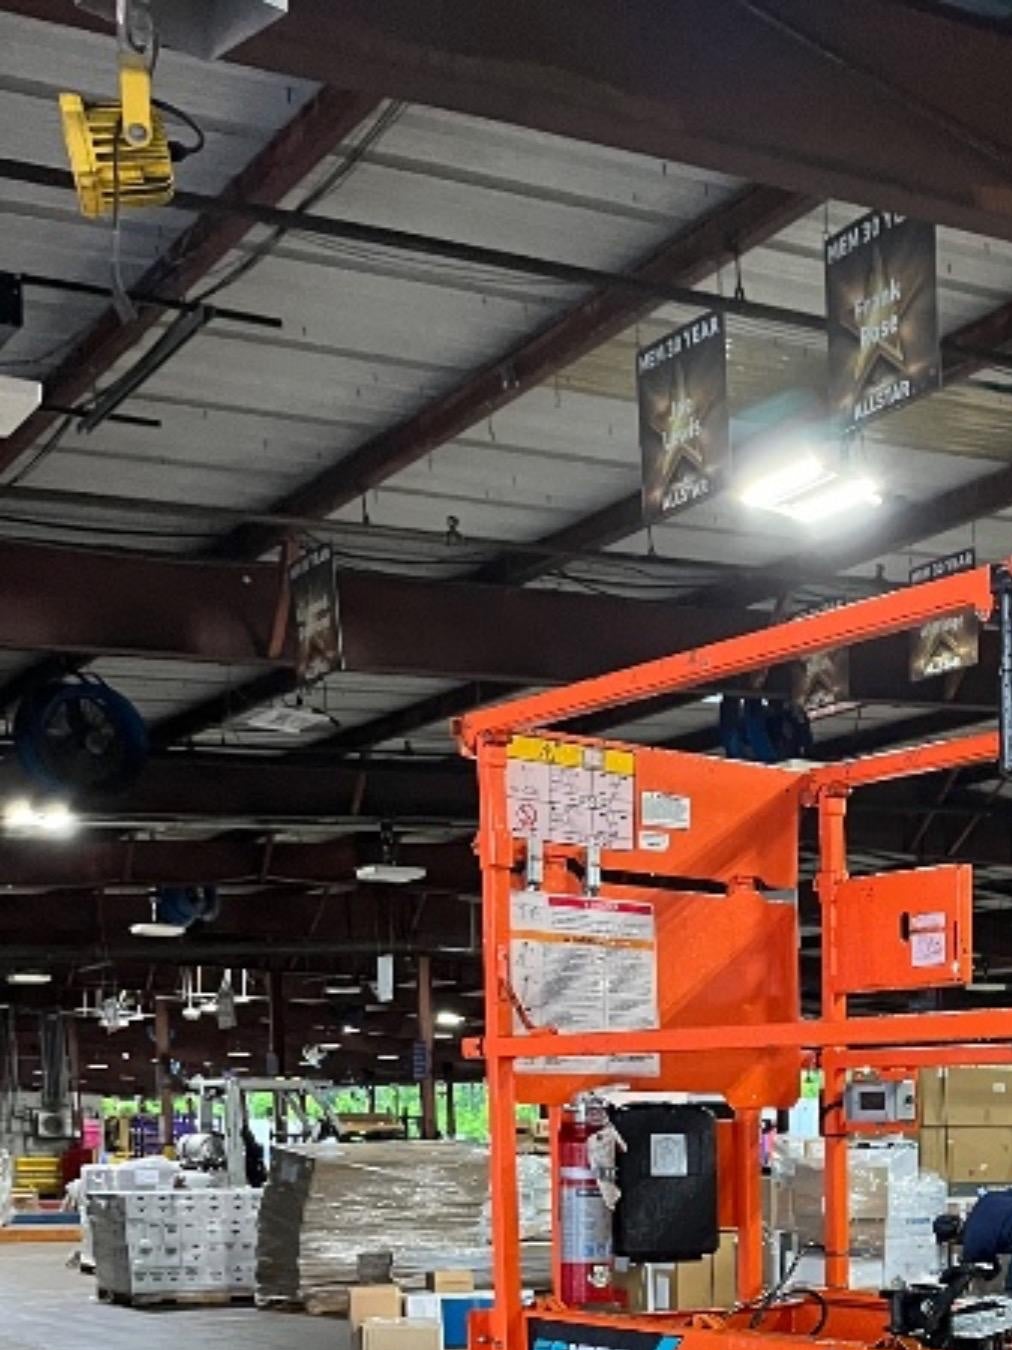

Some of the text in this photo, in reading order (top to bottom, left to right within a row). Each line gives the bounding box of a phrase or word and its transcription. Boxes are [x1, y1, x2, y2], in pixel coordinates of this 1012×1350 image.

[827, 227, 859, 265] MEM
[683, 316, 720, 350] YEAR
[854, 380, 911, 421] ALLSTAR
